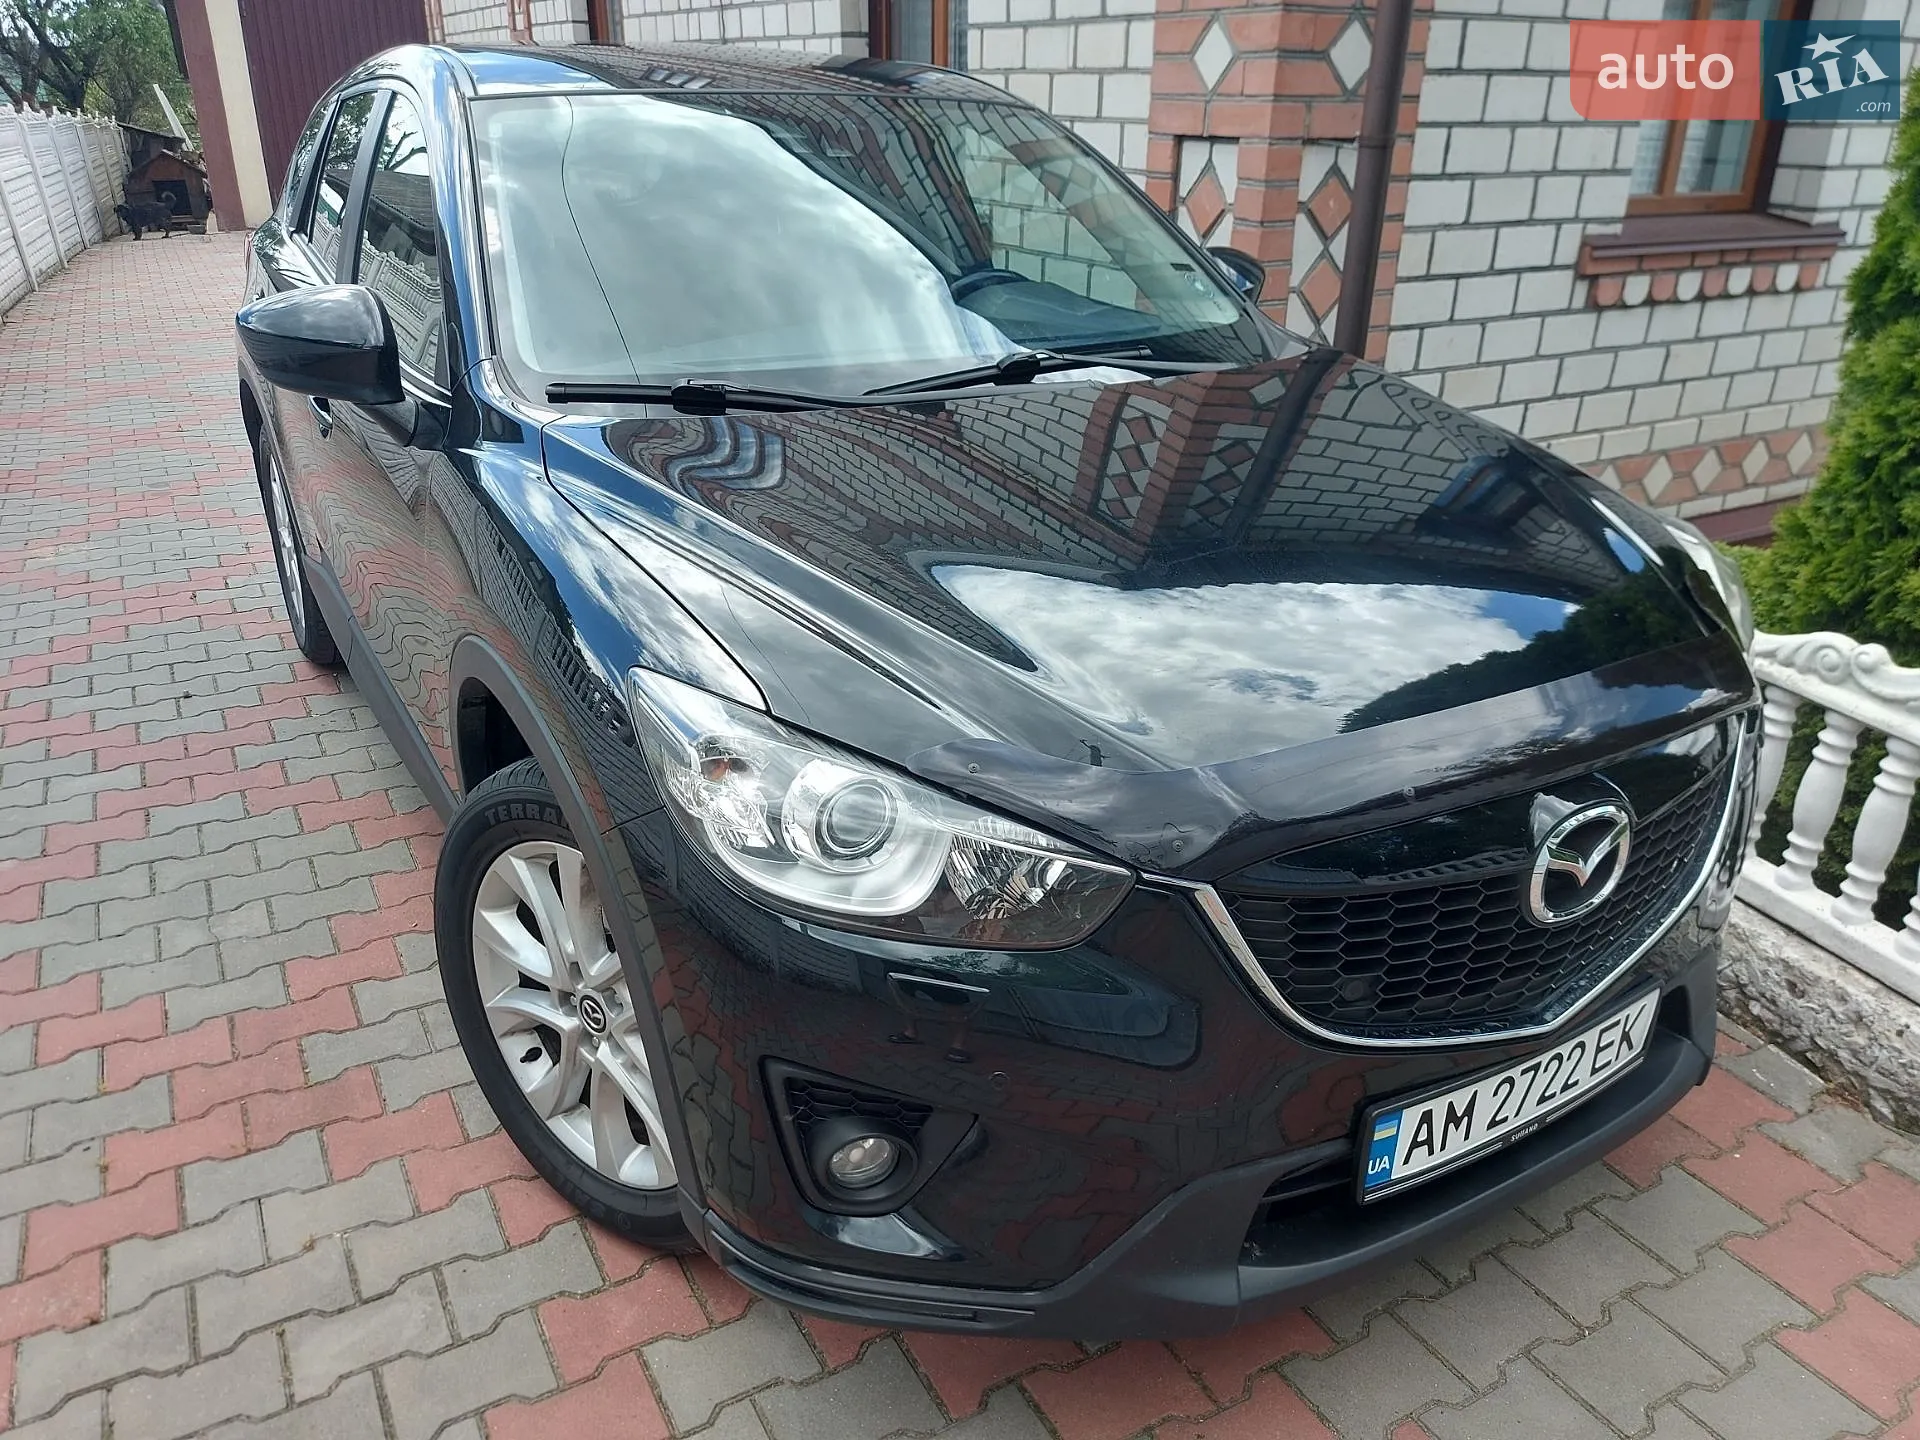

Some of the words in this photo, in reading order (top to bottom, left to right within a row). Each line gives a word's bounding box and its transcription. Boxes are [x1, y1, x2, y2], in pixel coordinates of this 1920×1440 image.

[1402, 1089, 1478, 1167] AM
[1486, 1040, 1586, 1131] 2722
[1590, 1003, 1648, 1078] EK
[1368, 1155, 1390, 1175] UA
